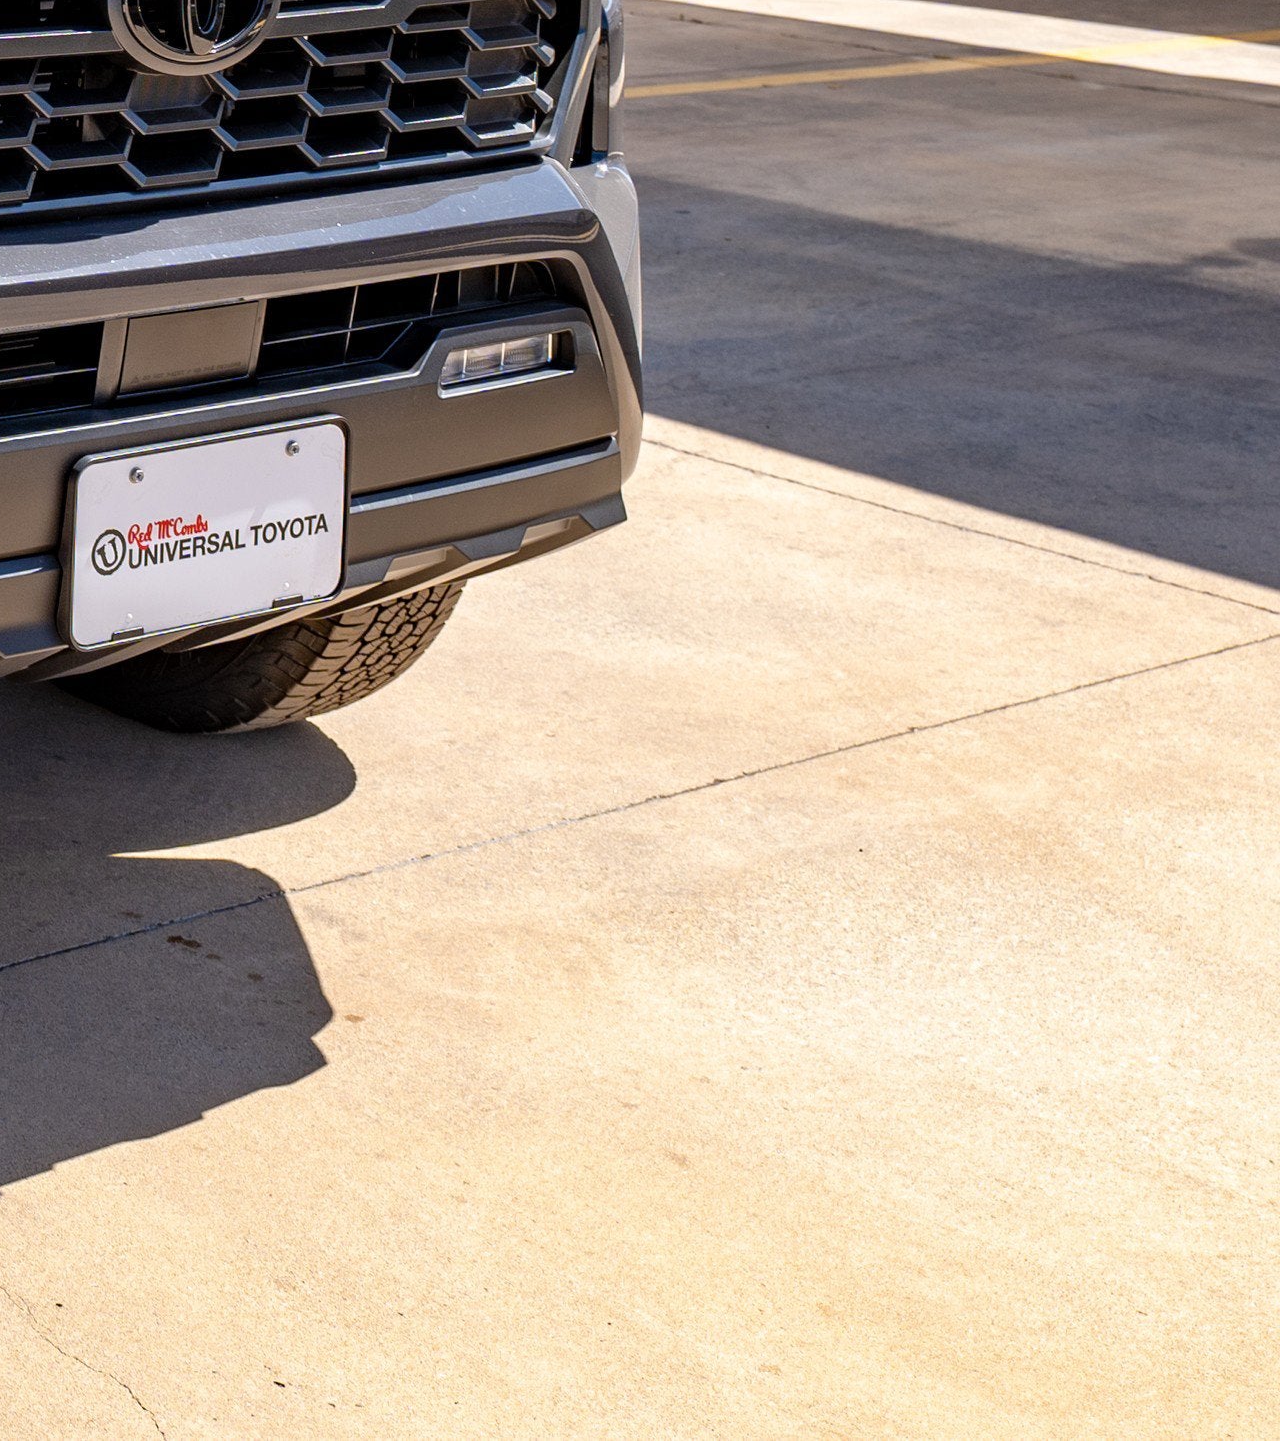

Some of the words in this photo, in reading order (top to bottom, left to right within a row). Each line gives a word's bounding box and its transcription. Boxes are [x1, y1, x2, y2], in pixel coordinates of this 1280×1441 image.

[128, 523, 152, 550] Red
[128, 529, 246, 570] UNIVERSAL
[250, 513, 329, 546] TOYOTA
